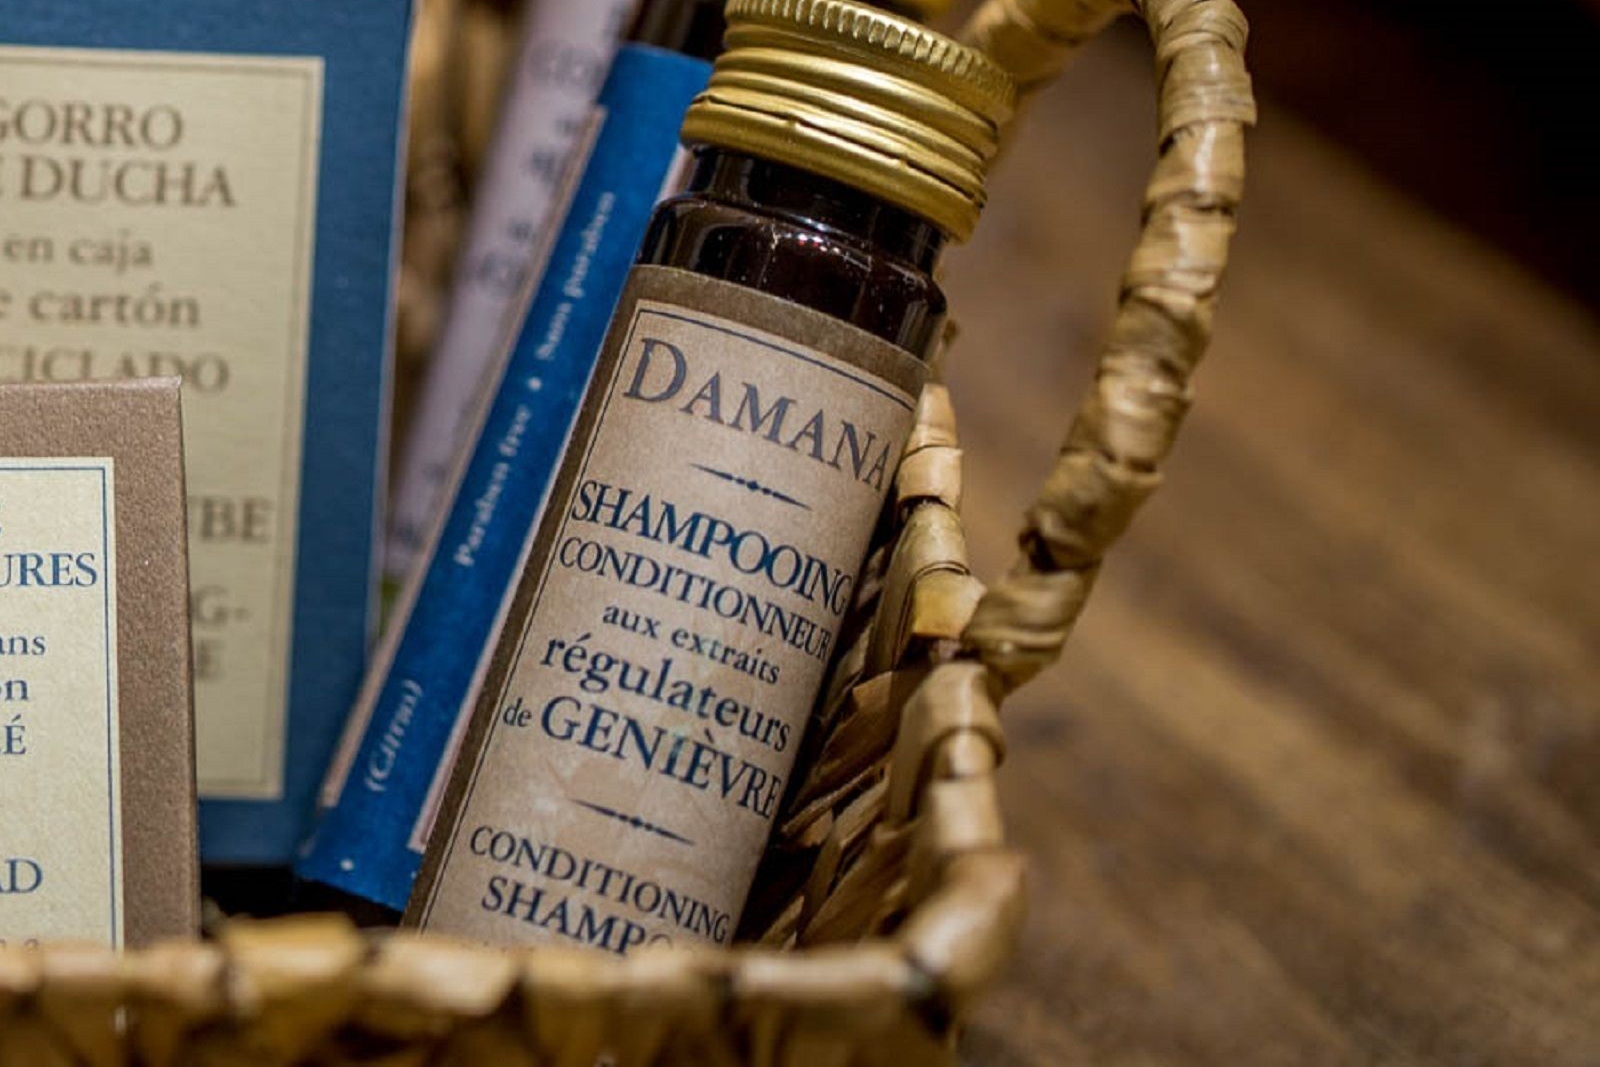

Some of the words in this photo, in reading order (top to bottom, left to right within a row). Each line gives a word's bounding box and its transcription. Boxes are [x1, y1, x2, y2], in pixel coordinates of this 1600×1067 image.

[19, 155, 237, 208] DUCHA
[3, 234, 54, 264] en
[68, 228, 153, 274] caja
[28, 281, 200, 329] cartón
[622, 336, 893, 493] DAMANA
[559, 536, 833, 662] CONDITIONNEUR
[571, 479, 853, 617] SHAMPOOING
[540, 632, 792, 753] régulateurs
[603, 603, 661, 640] aux
[671, 627, 782, 685] extraits
[503, 697, 533, 728] de
[541, 694, 783, 821] GENIÈVRE
[469, 824, 733, 945] CONDITIONING
